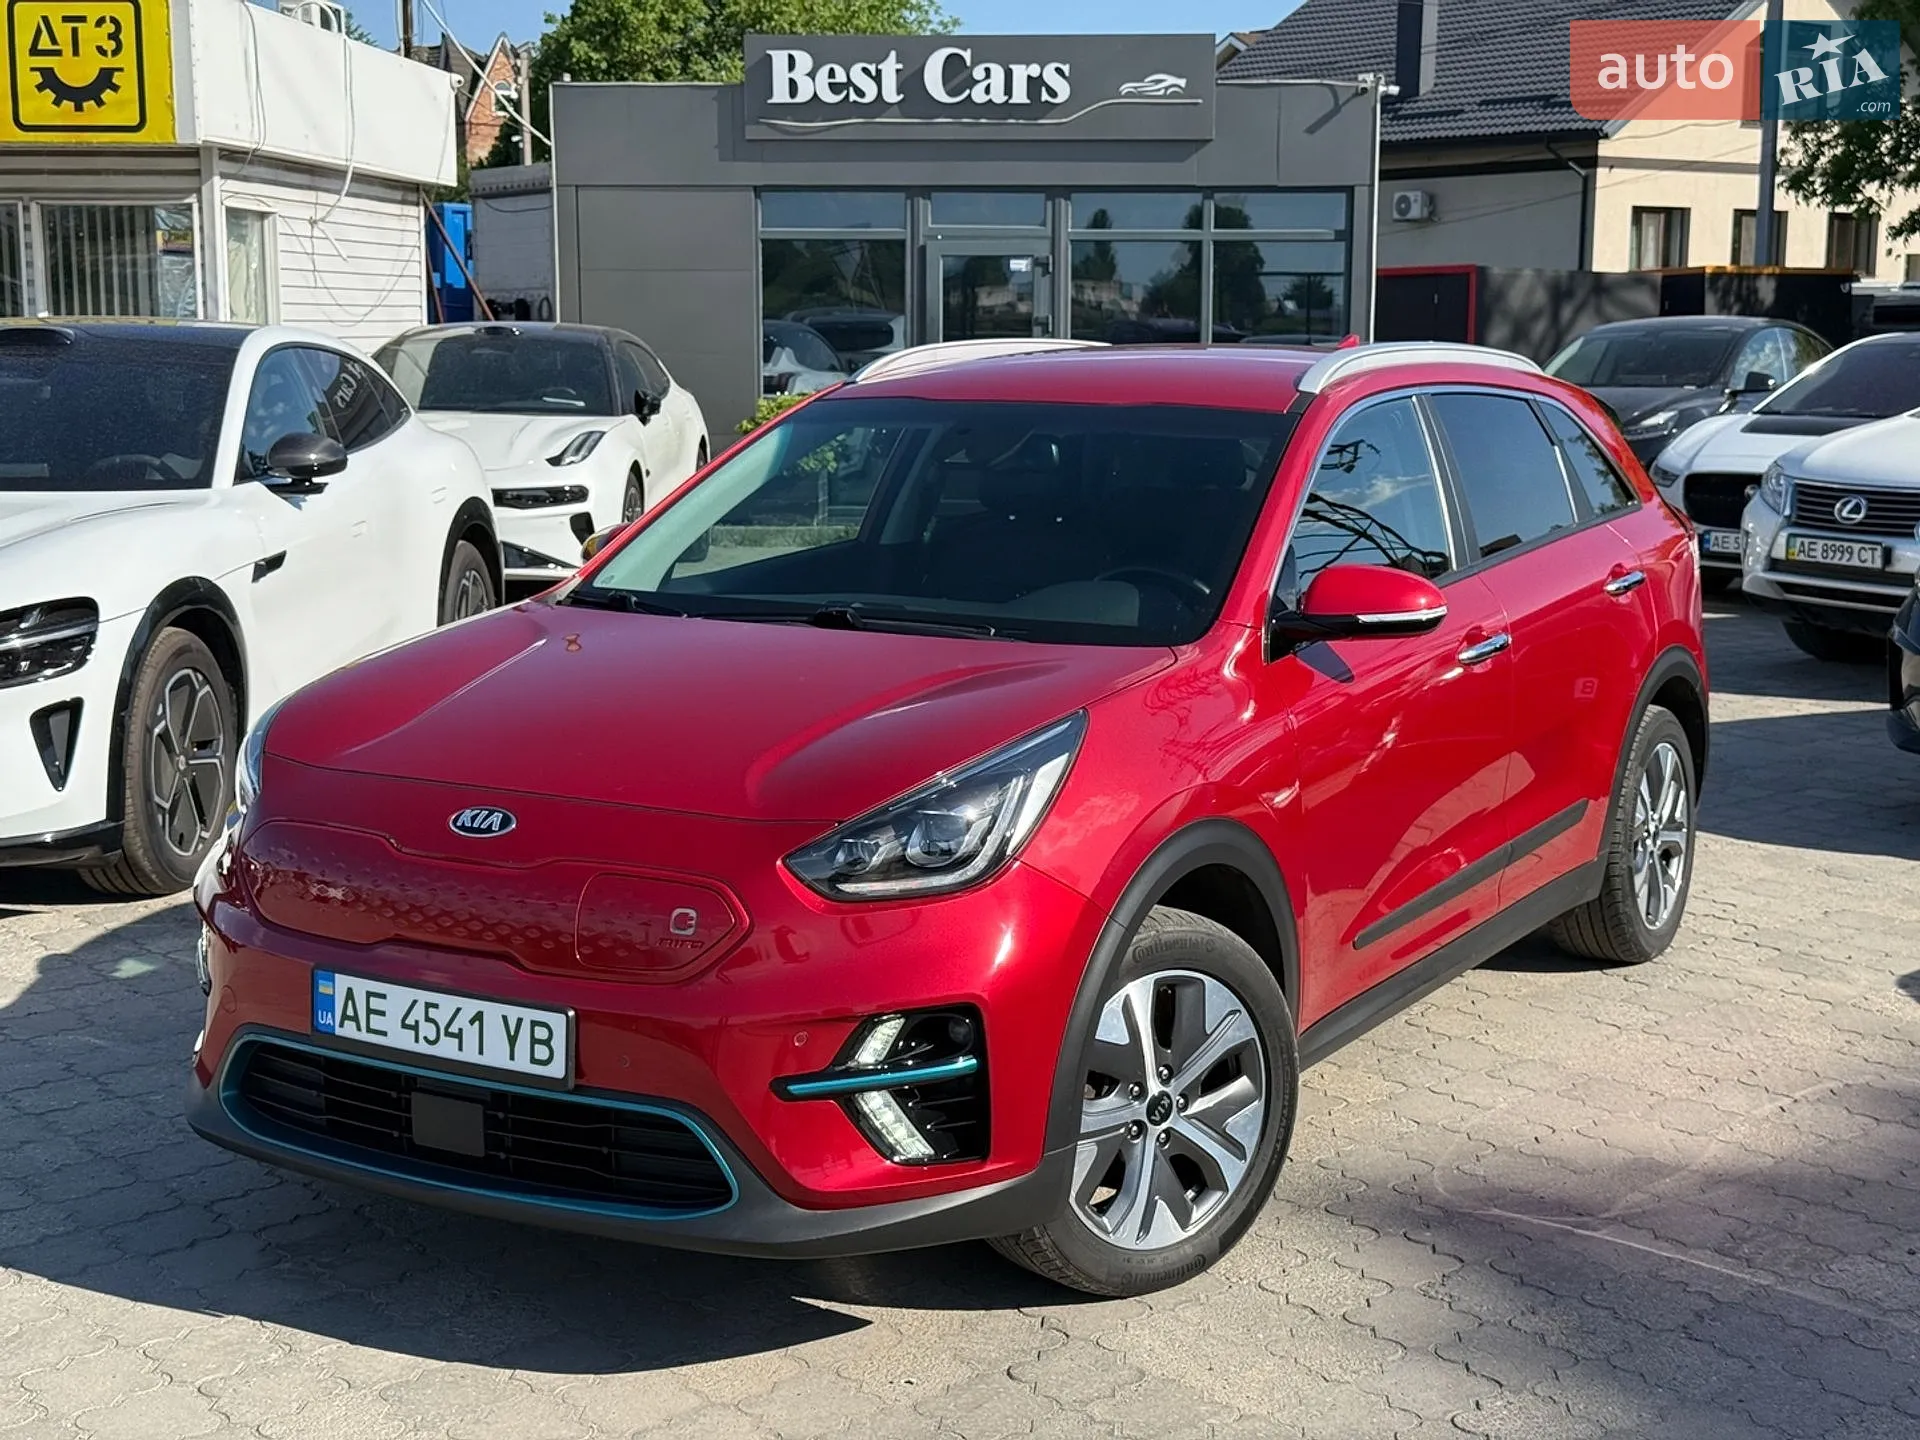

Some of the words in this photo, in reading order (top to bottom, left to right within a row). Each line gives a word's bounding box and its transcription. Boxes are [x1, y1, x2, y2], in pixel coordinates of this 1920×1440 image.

[766, 49, 904, 104] Best
[923, 47, 1071, 104] Cars
[1711, 535, 1730, 550] AE
[1797, 540, 1818, 559] AE
[1821, 543, 1854, 562] 8999
[1857, 546, 1878, 564] CT
[456, 809, 503, 831] KIA
[318, 1009, 334, 1026] UA
[338, 986, 388, 1037] AE
[400, 999, 485, 1056] 4541
[501, 1014, 555, 1067] YB
